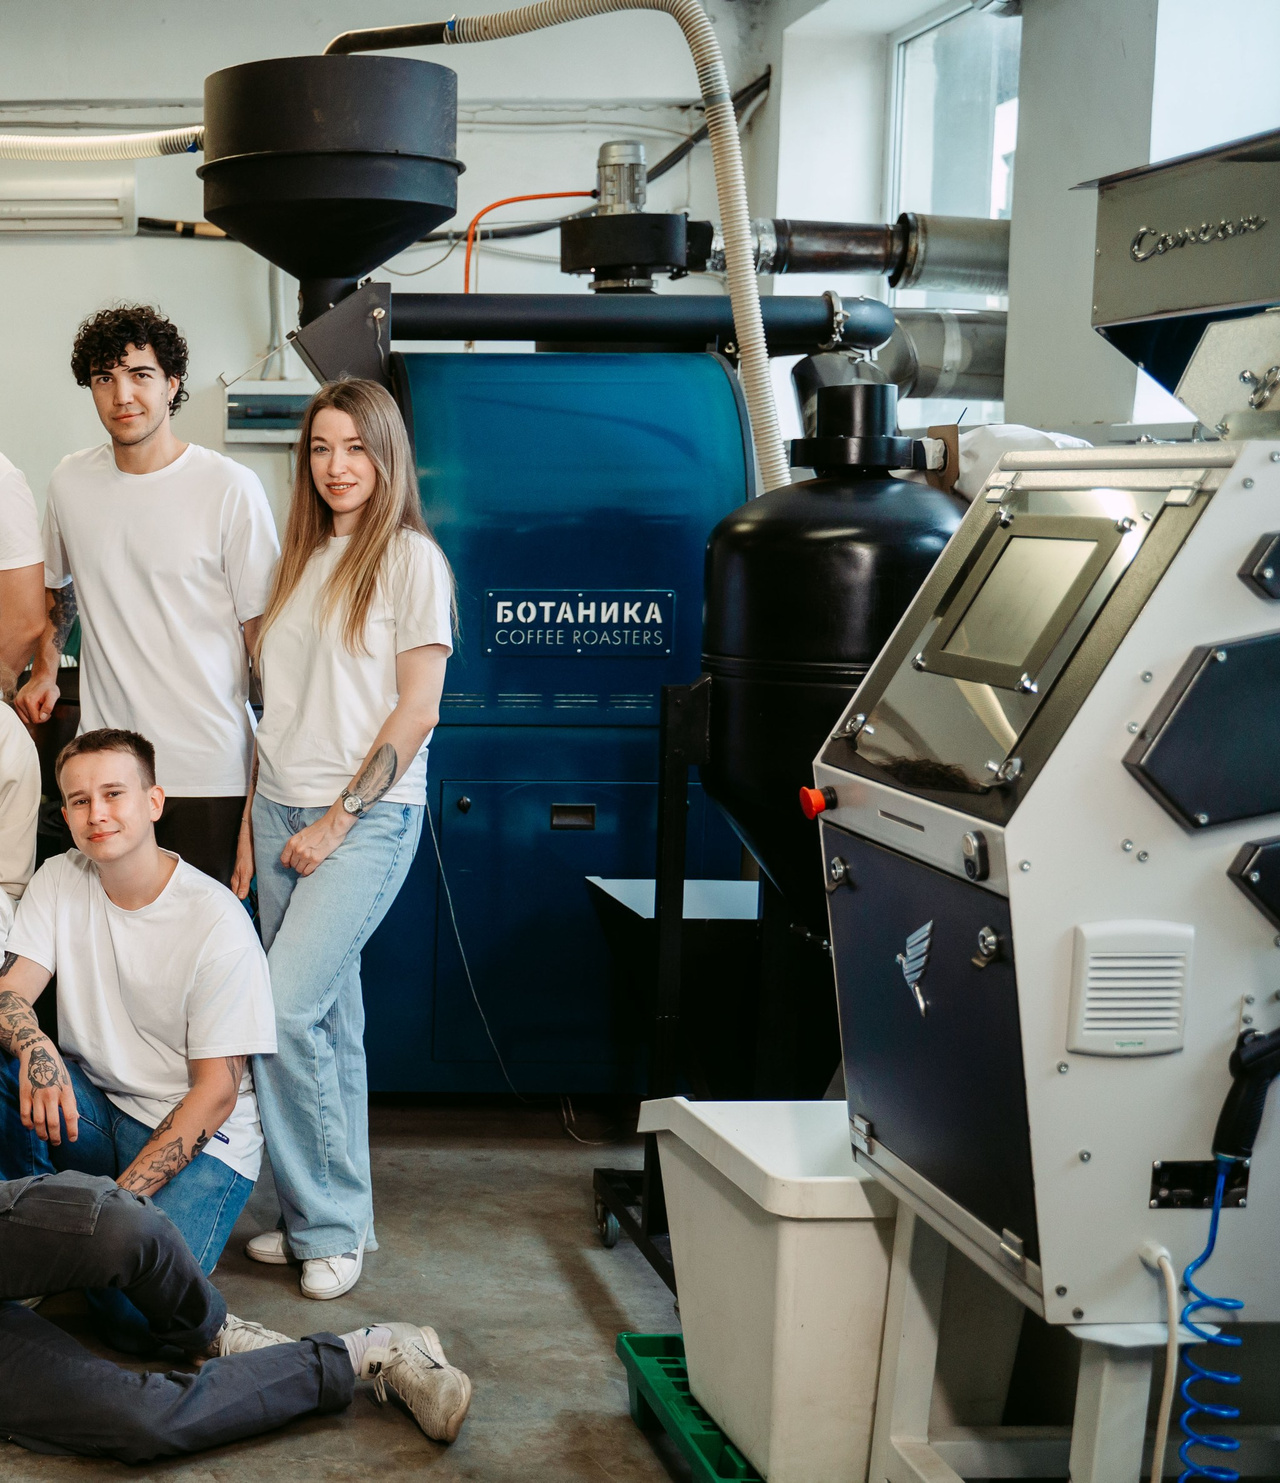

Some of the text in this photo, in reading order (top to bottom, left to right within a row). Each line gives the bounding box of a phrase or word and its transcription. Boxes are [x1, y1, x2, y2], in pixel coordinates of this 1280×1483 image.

[496, 601, 663, 624] БОТАНИКА
[495, 629, 663, 646] COFFEE ROASTERS
